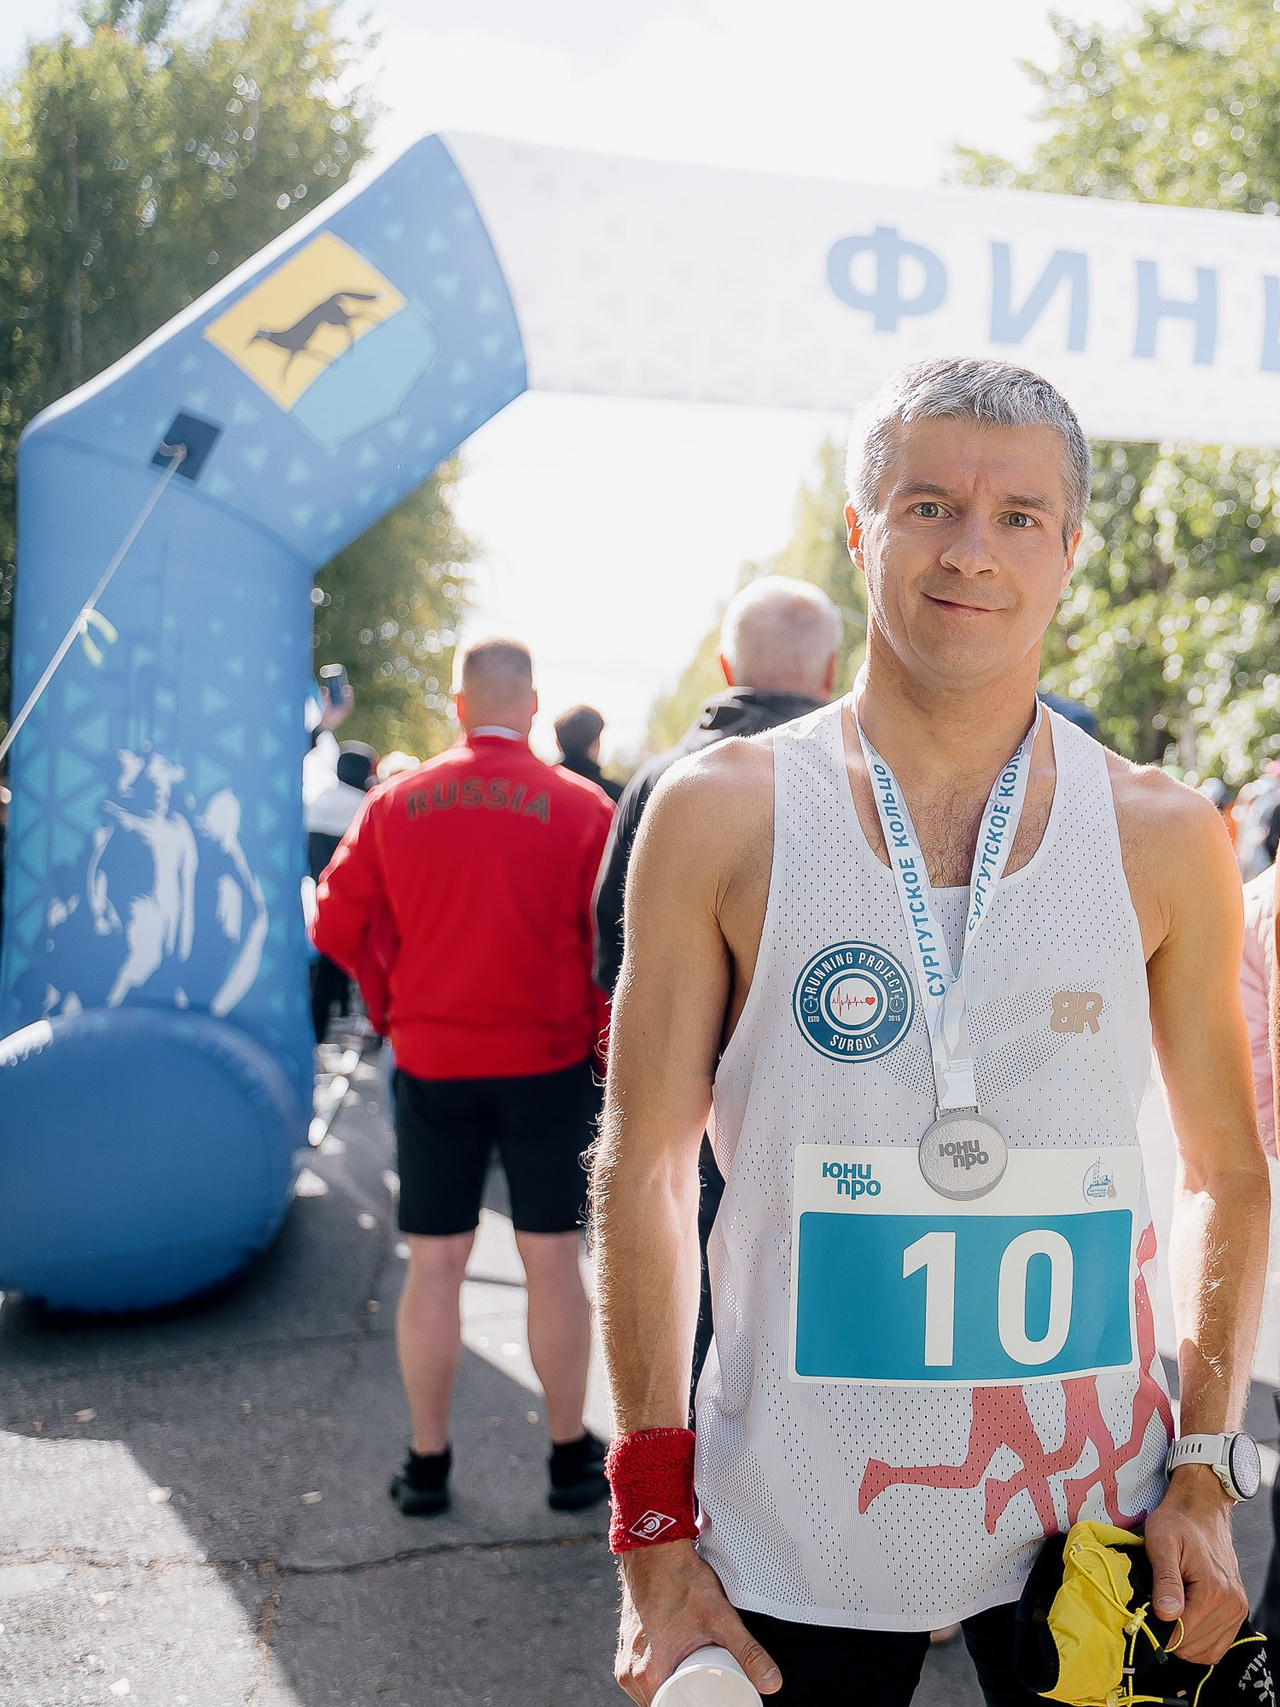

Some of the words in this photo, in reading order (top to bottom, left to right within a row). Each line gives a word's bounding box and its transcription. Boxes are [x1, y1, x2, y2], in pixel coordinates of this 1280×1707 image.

[404, 777, 551, 825] RUSSIA
[873, 763, 910, 848] КОЛЬЦО
[968, 804, 1010, 932] СУРГУТСКОЕ
[898, 857, 946, 998] СУРГУТСКОЕ
[804, 952, 853, 995] RUNNING
[858, 952, 904, 994] PROJECT
[829, 1033, 880, 1052] SURGUT
[903, 1229, 1074, 1367] 10
